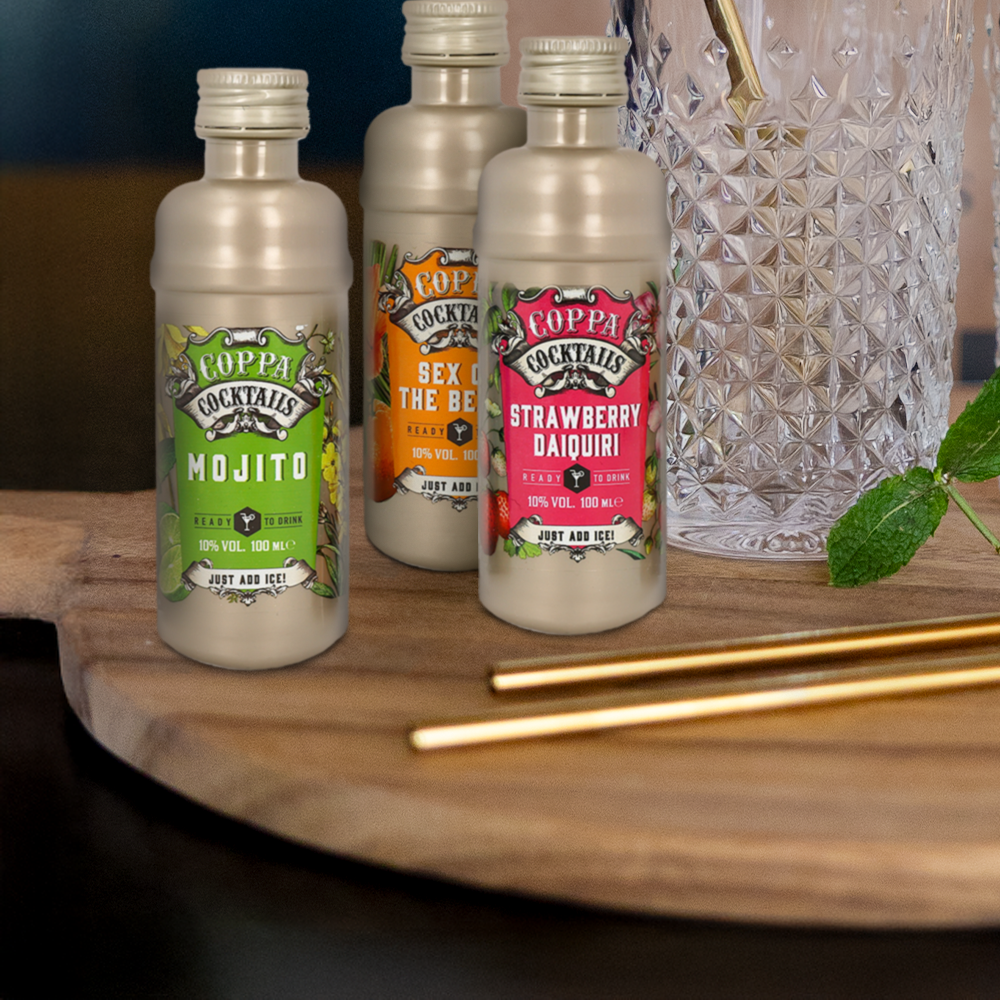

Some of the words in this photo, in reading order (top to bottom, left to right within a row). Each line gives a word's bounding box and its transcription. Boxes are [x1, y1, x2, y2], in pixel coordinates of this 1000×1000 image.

[529, 308, 620, 340] COPPA
[200, 351, 292, 382] COPPA
[526, 343, 626, 374] COCKTAILS
[418, 361, 462, 385] SEX
[197, 386, 298, 416] COCKTAILS
[399, 387, 439, 411] THE
[510, 403, 642, 430] STRAWBERRY
[407, 425, 444, 436] READY
[412, 447, 432, 459] 10%
[434, 449, 458, 460] VOL.
[533, 433, 620, 461] DAIQUIRI
[187, 452, 308, 482] MOJITO
[422, 480, 447, 491] JUST
[452, 482, 471, 492] ADD
[523, 473, 561, 483] READY
[594, 473, 605, 482] TO
[607, 472, 630, 482] DRINK
[528, 495, 549, 508] 10%
[551, 496, 575, 508] VOL.
[580, 496, 599, 508] 100
[194, 516, 231, 526] READY
[264, 517, 275, 526] TO
[278, 515, 303, 525] DRINK
[538, 530, 563, 542] JUST
[569, 530, 590, 542] ADD
[594, 529, 614, 541] ICE!
[199, 539, 219, 552] 10%
[221, 540, 246, 552] VOL.
[251, 540, 270, 552] 100
[209, 573, 234, 585] JUST
[239, 574, 260, 585] ADD
[265, 573, 286, 584] ICE!
